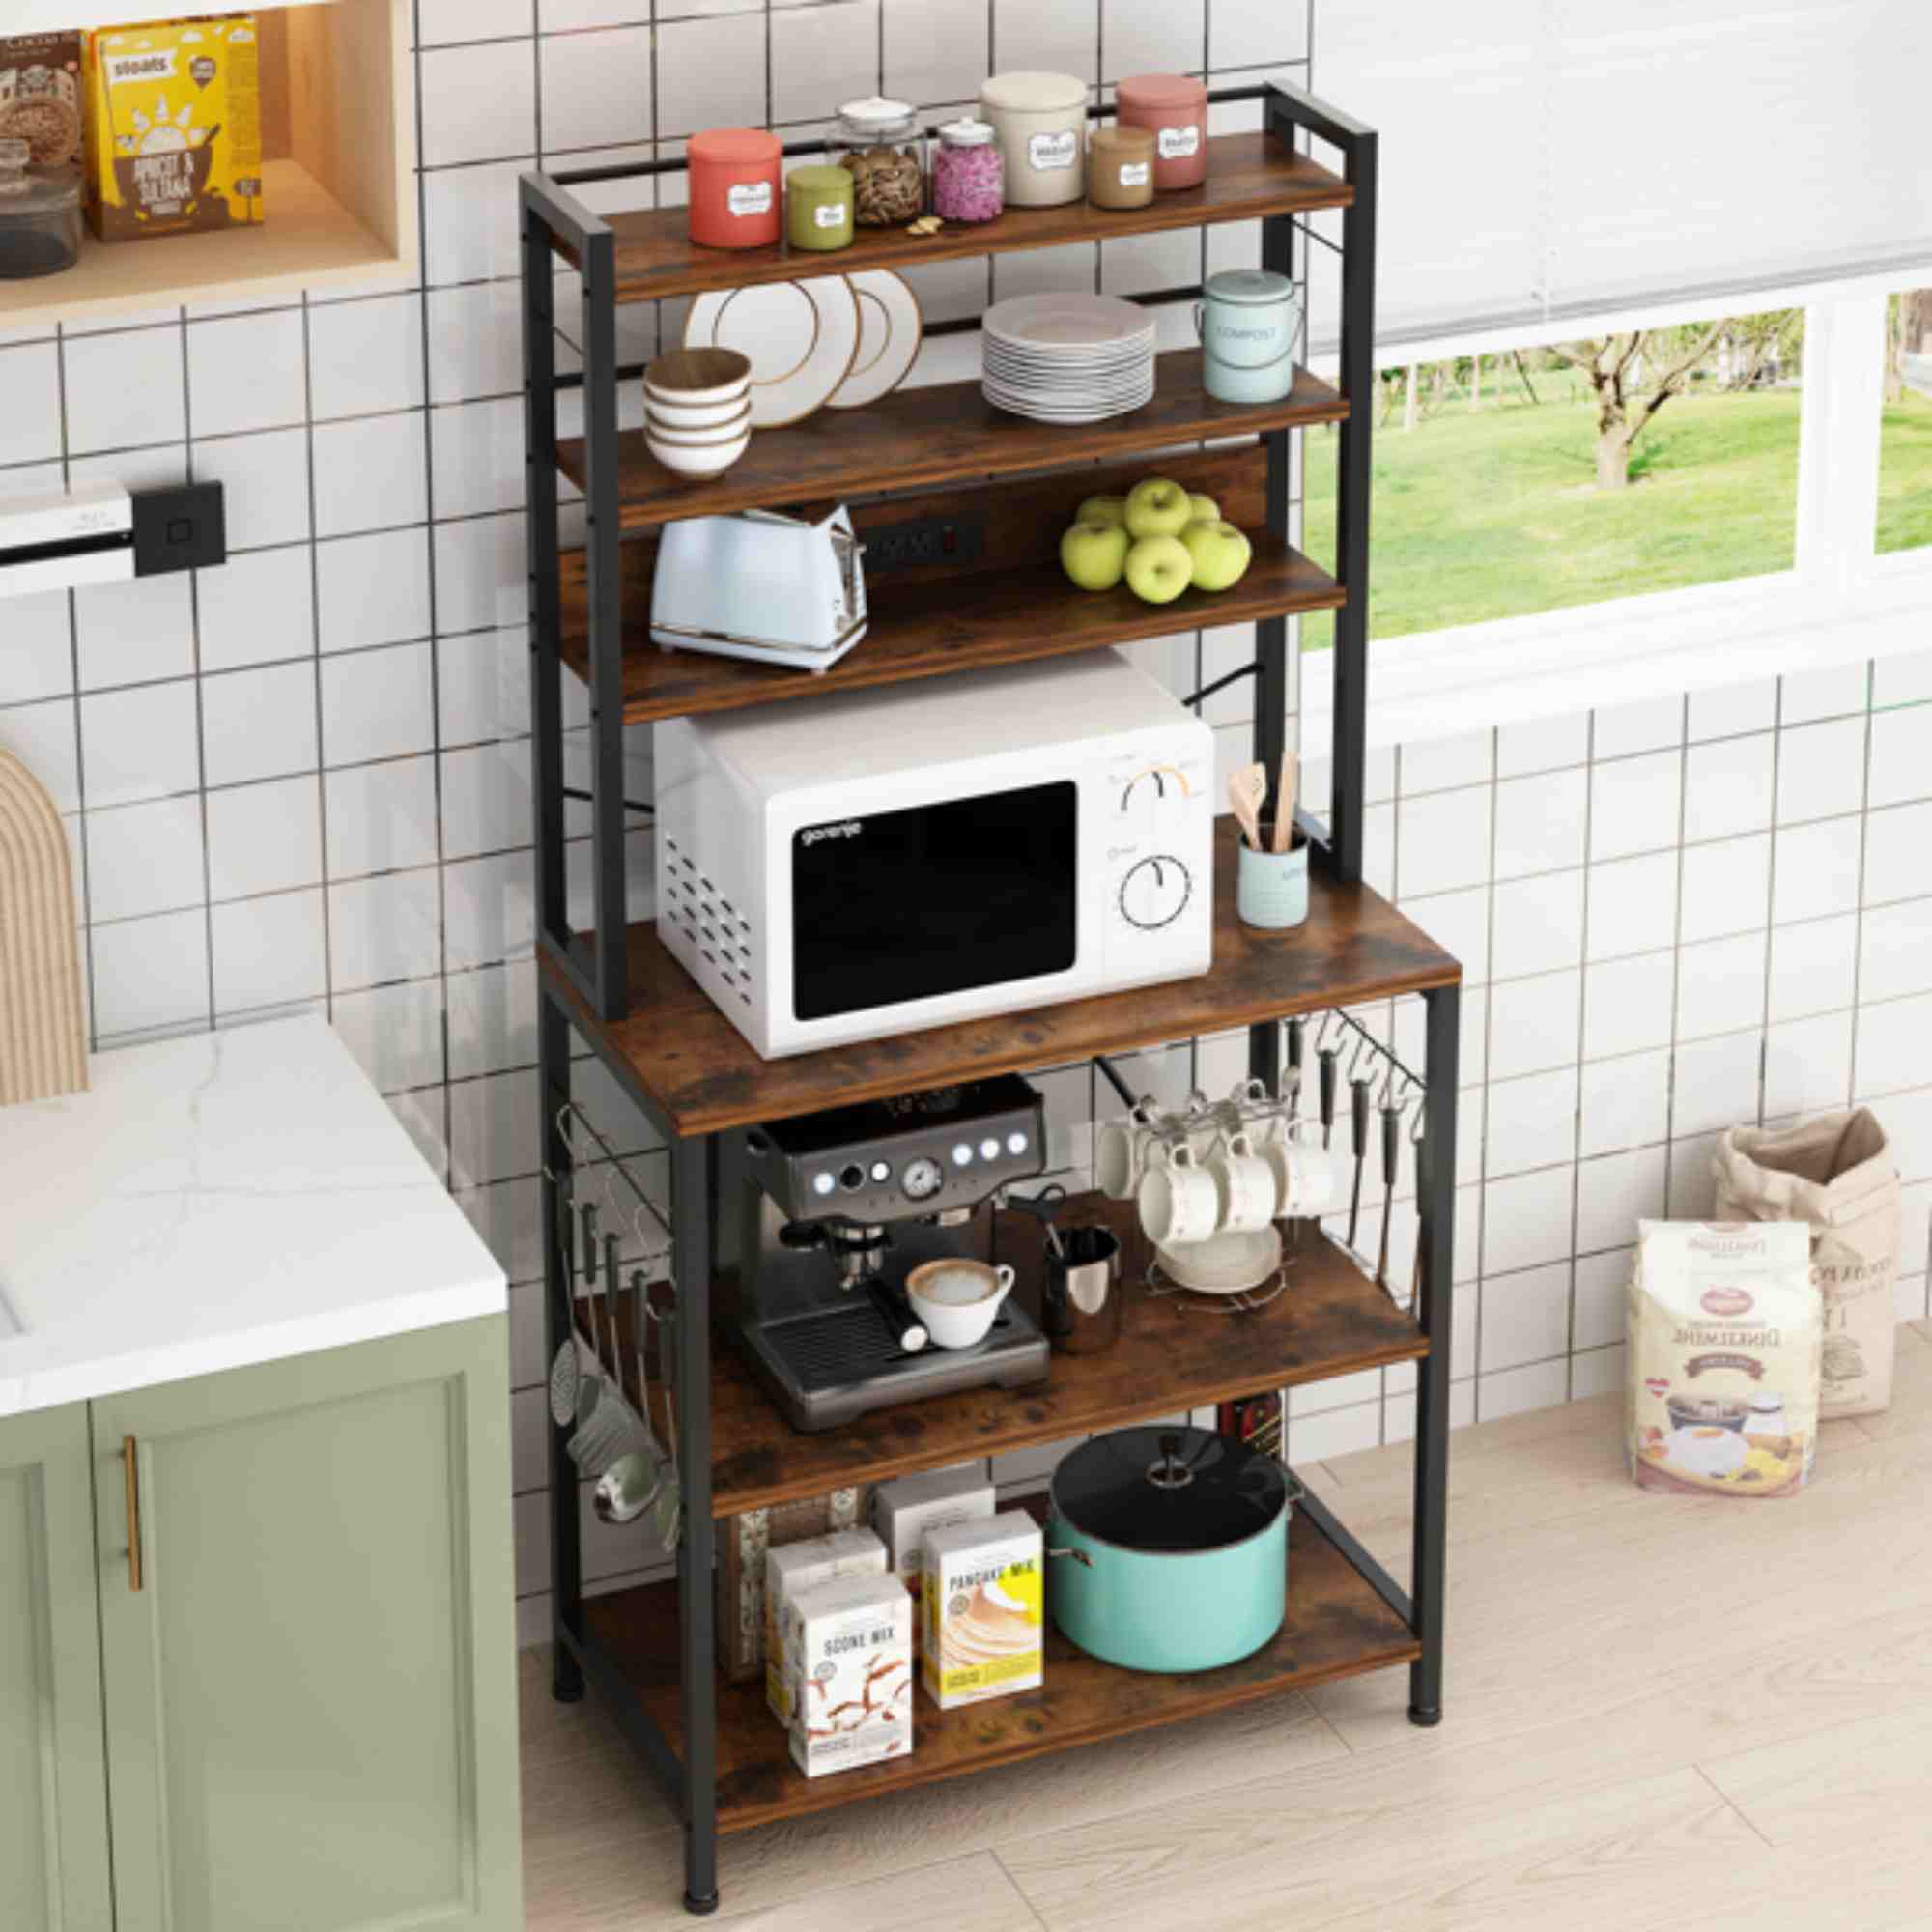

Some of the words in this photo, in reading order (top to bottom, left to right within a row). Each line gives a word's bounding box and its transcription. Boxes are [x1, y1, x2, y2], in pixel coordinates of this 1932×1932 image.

[114, 55, 168, 77] stoats
[801, 821, 862, 847] gorenje
[949, 1566, 1005, 1592] PANCAKE
[1009, 1557, 1036, 1578] MIX
[823, 1632, 867, 1656] SCONE
[870, 1626, 896, 1645] MIX
